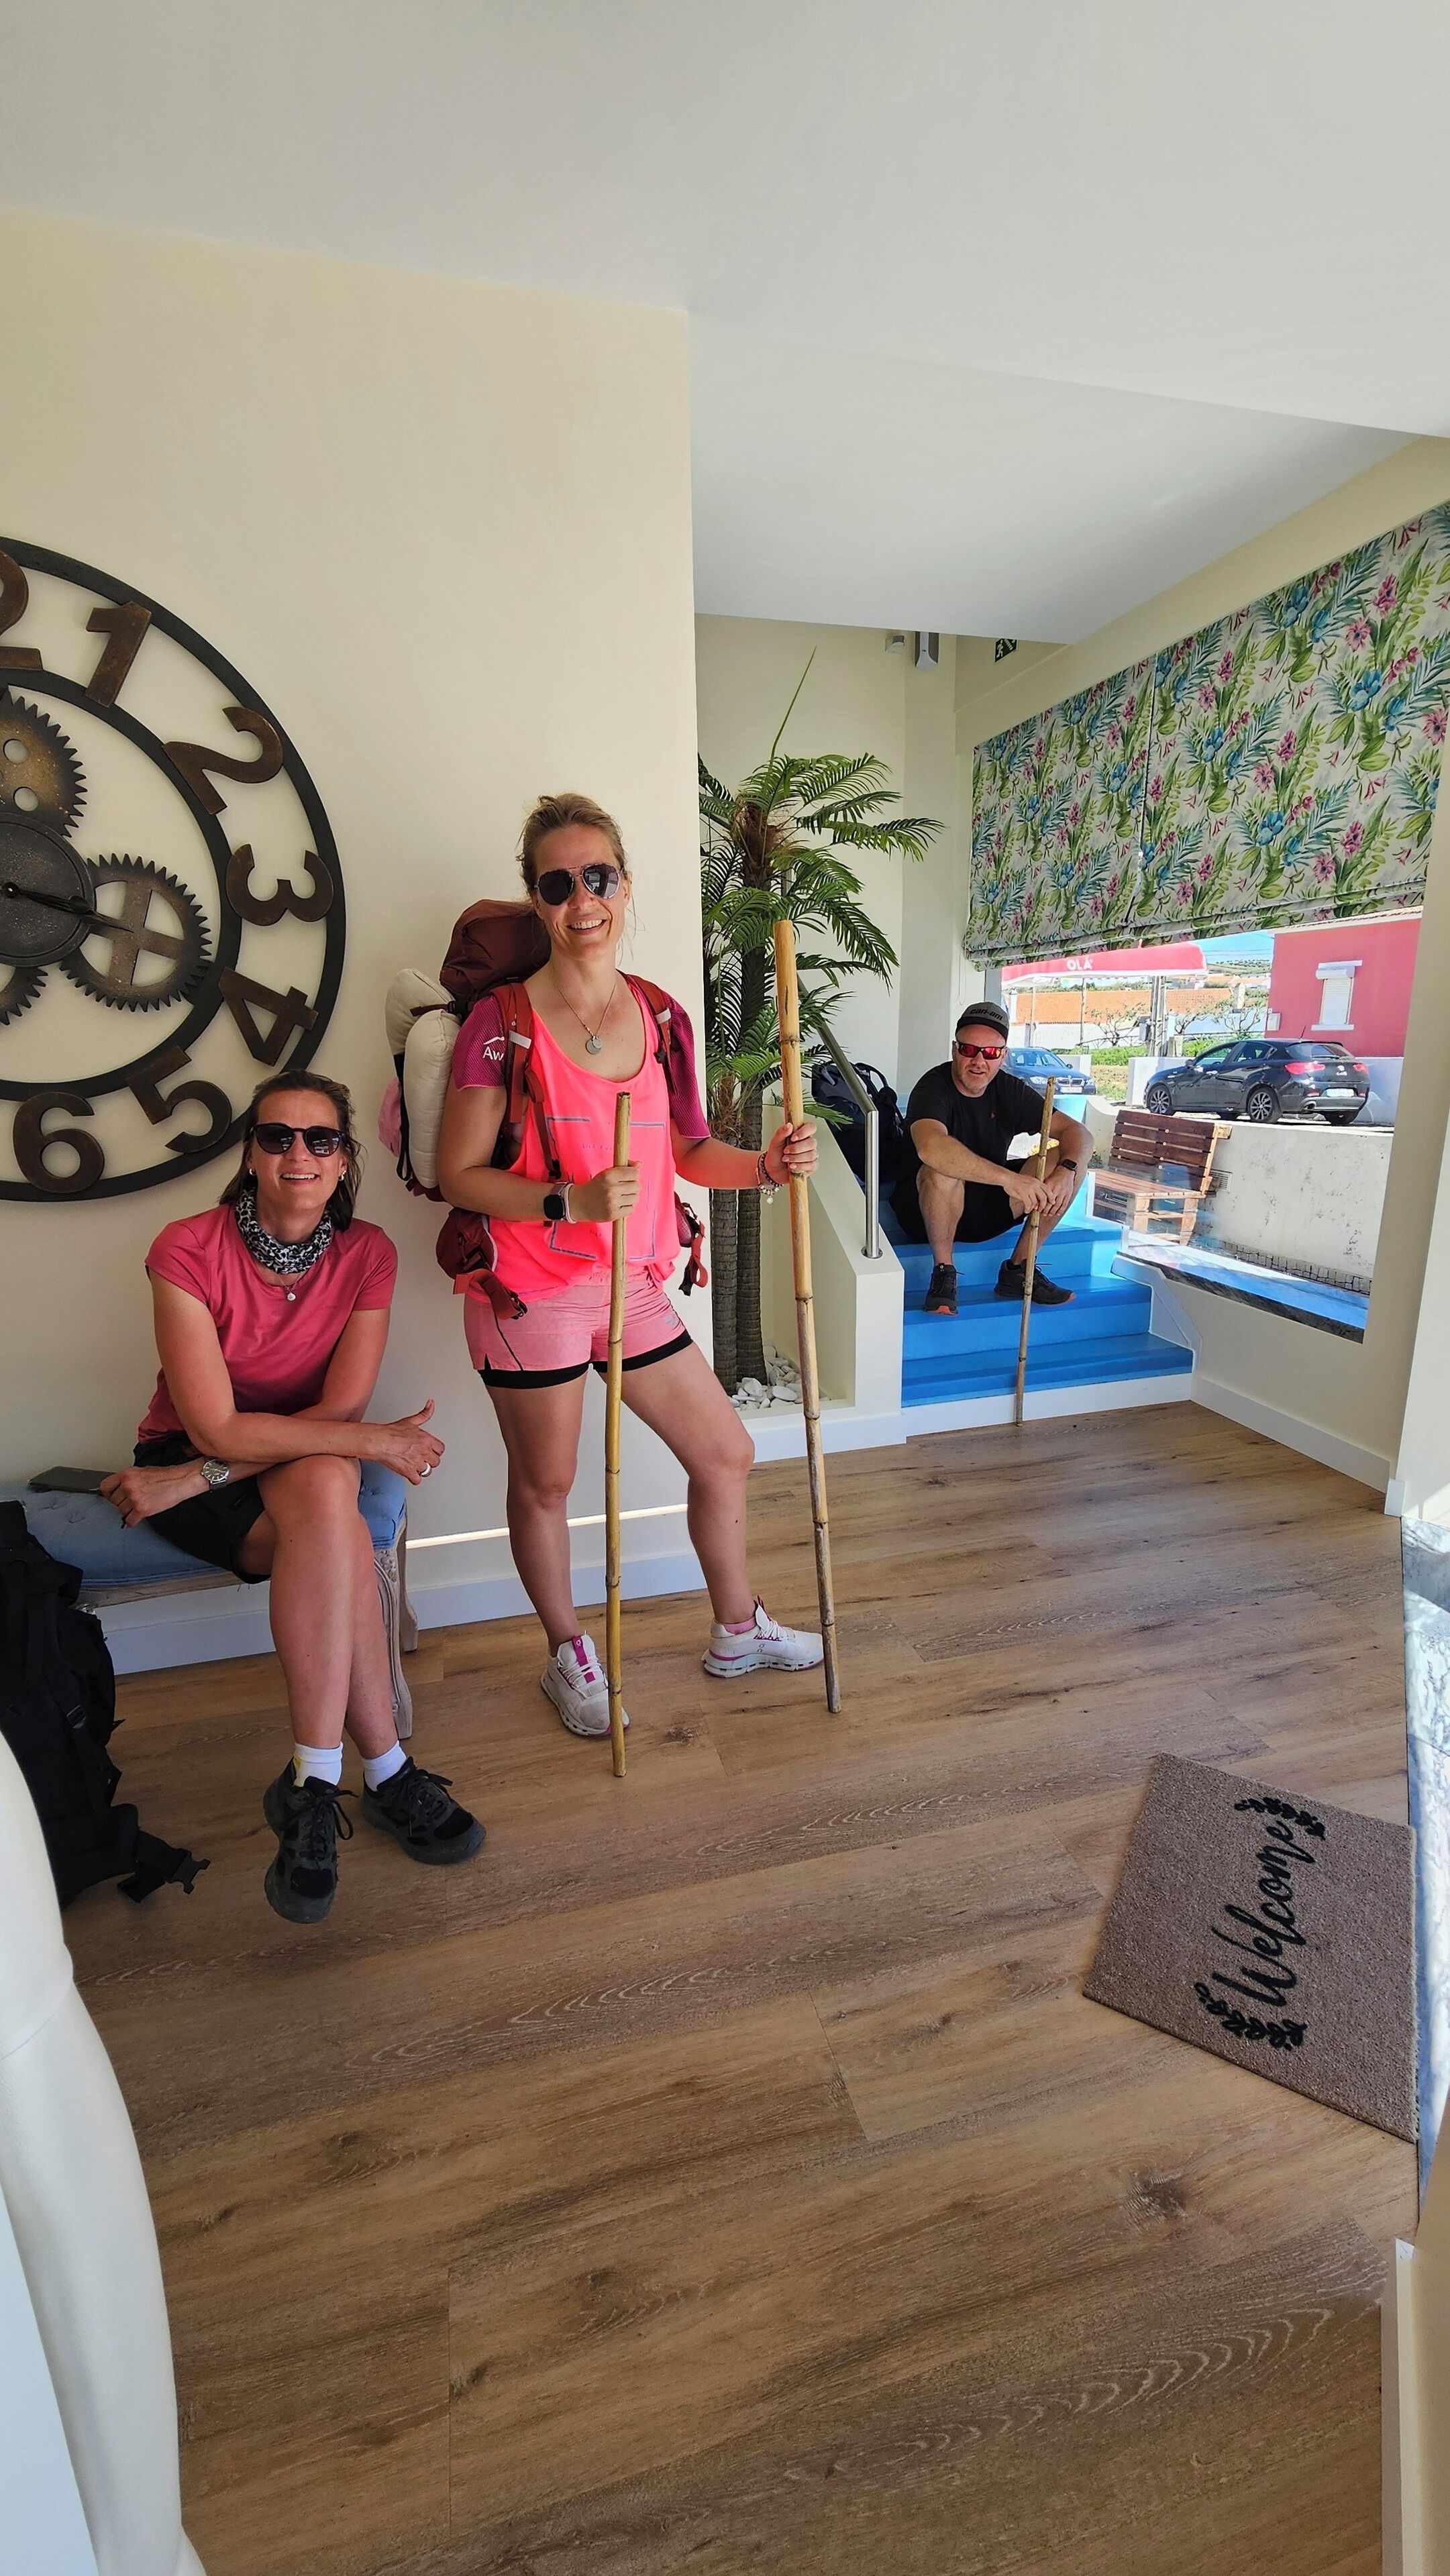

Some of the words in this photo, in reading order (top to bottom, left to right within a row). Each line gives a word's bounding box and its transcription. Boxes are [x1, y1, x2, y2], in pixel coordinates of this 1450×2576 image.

[85, 600, 152, 708] 1
[162, 705, 283, 814] 2
[225, 843, 333, 927] 3
[218, 965, 319, 1067] 4
[12, 1090, 105, 1193] 6
[126, 1046, 232, 1155] 5
[1212, 1820, 1315, 2008] Welcome
